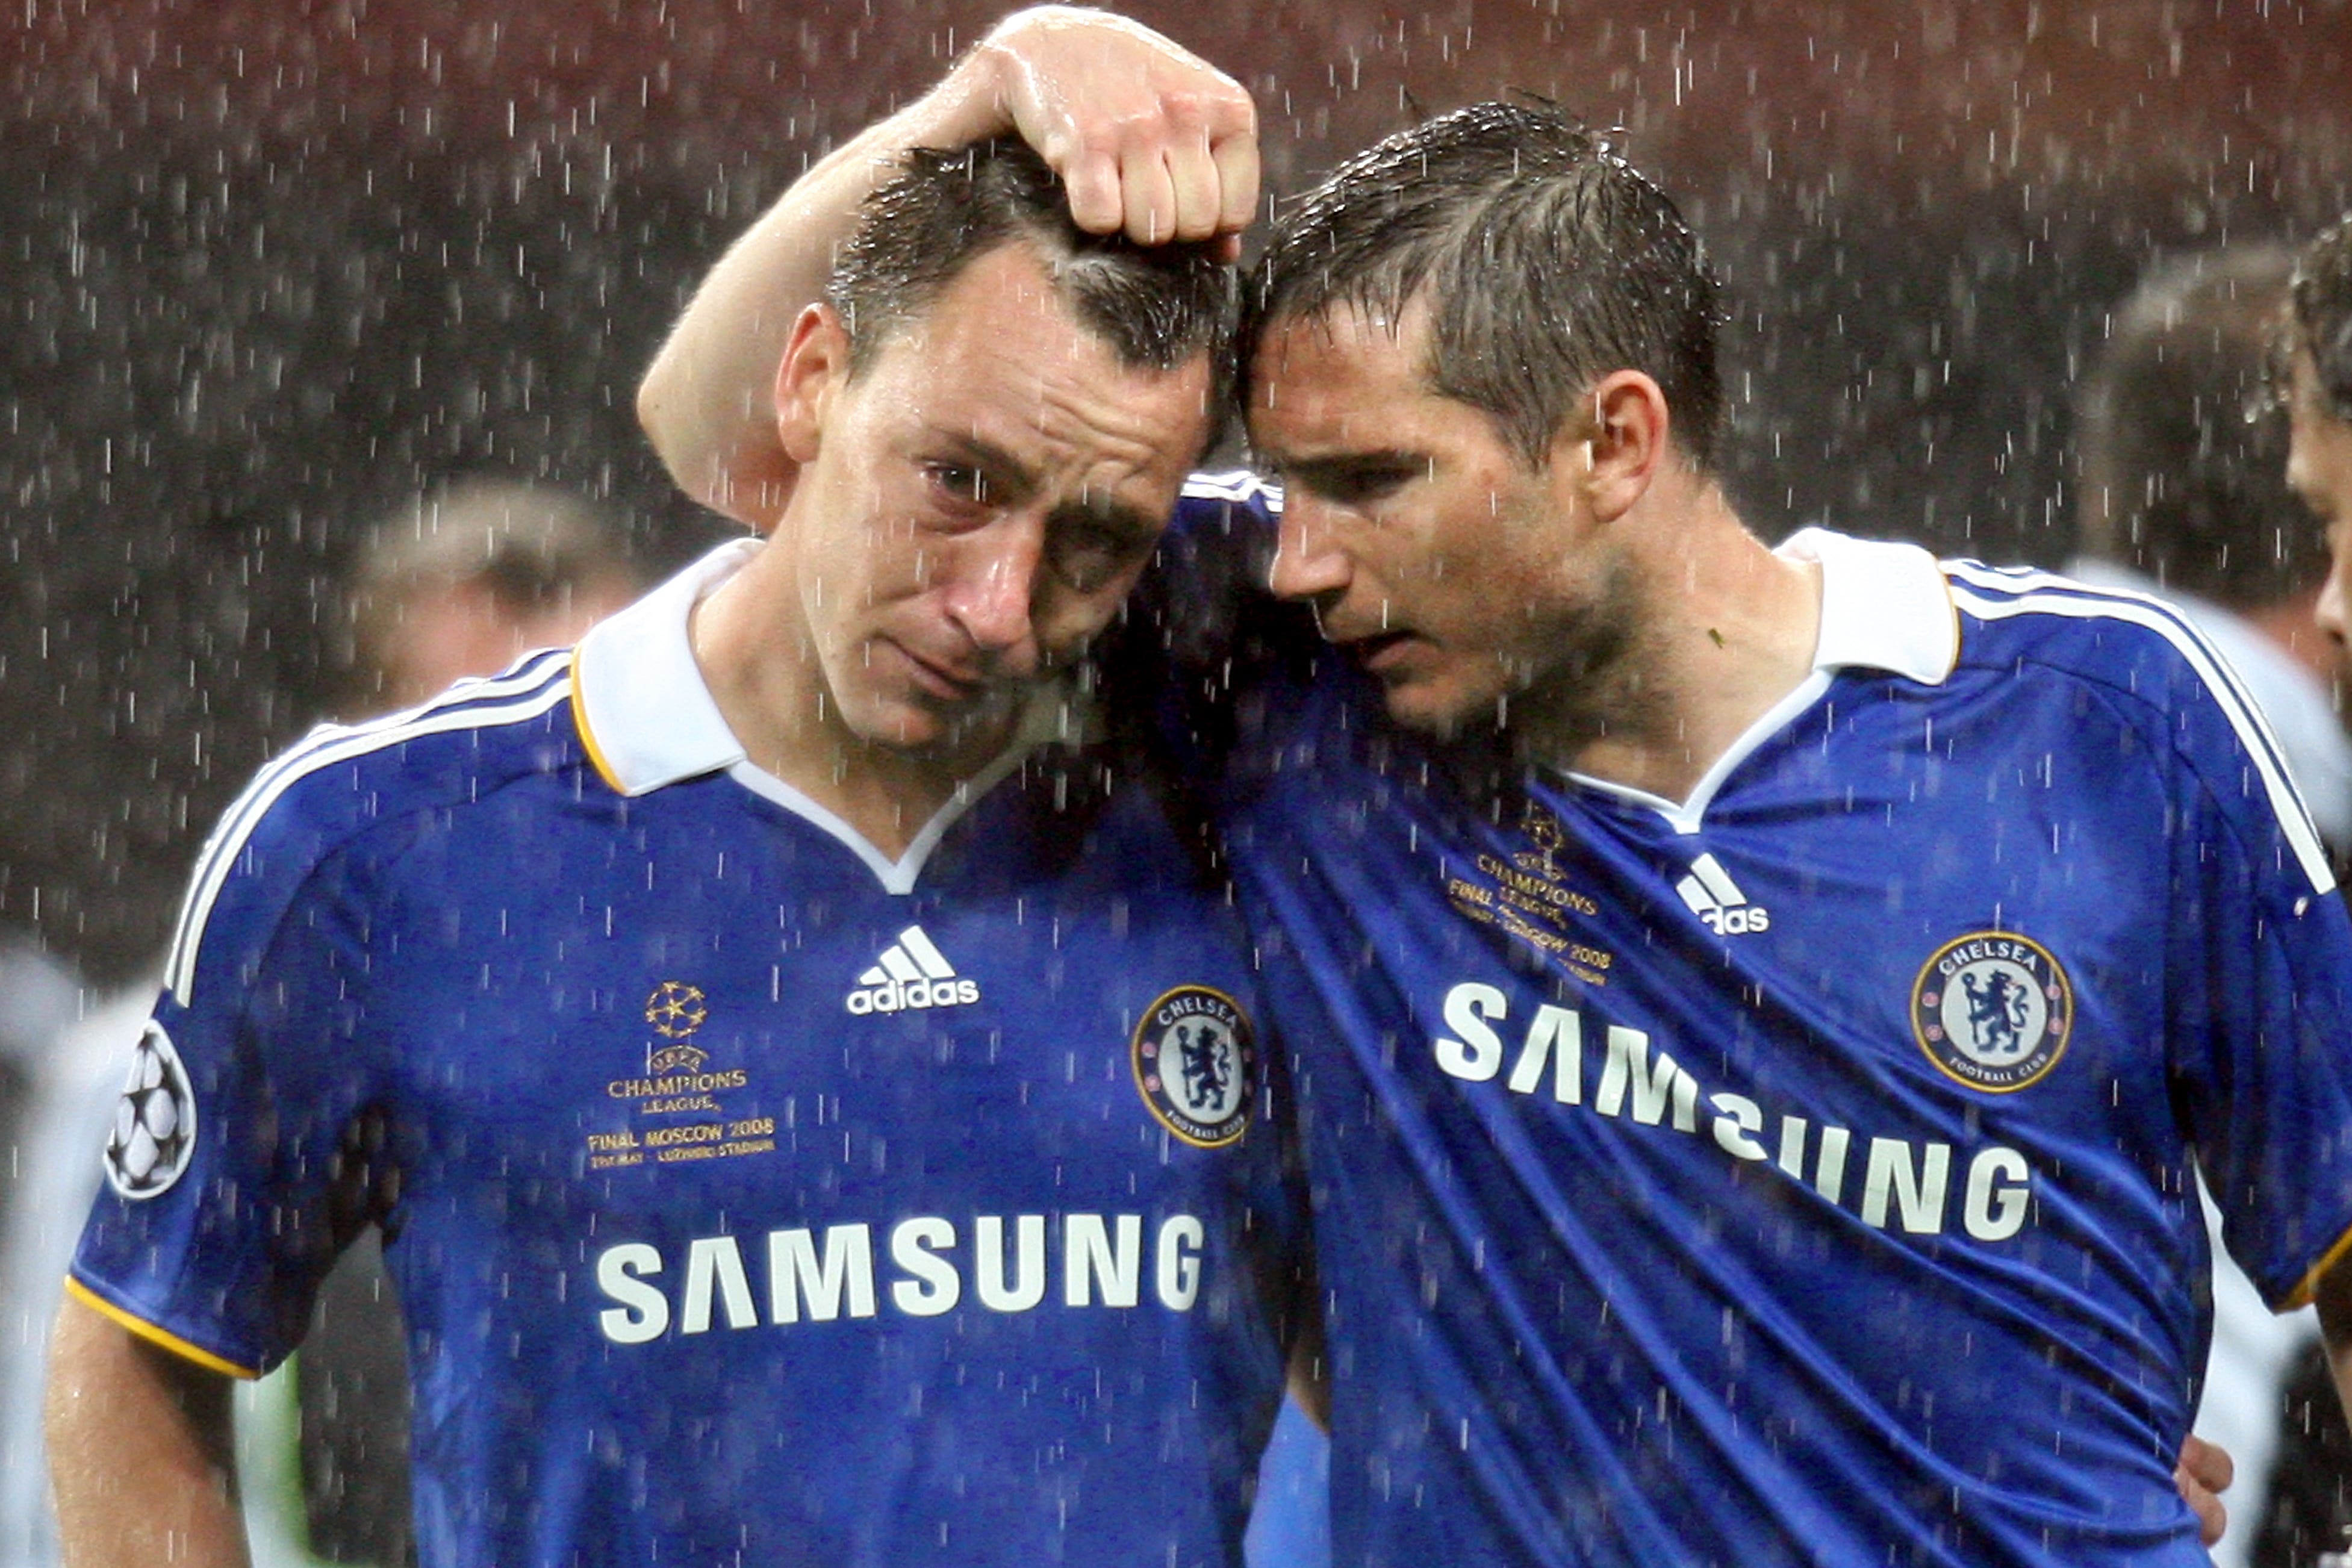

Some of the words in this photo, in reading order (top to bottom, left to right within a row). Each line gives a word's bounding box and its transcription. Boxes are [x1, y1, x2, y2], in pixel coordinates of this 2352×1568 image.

[1570, 944, 1612, 969] 2008
[1938, 941, 2038, 976] CHELSEA
[846, 977, 980, 1015] adidas
[1158, 997, 1237, 1029] CHELSEA
[1949, 1057, 2013, 1081] FOOTBALL
[2018, 1053, 2047, 1077] CLUB
[608, 1069, 747, 1098] CHAMPIONS
[641, 1095, 715, 1114] LEAGUE
[1434, 981, 2029, 1242] SAMSUNG
[588, 1132, 640, 1153] FINAL
[646, 1123, 723, 1147] MOSCOW
[729, 1118, 775, 1137] 2008
[1166, 1110, 1219, 1139] FOOTBALL
[597, 1213, 1204, 1344] SAMSUNG
